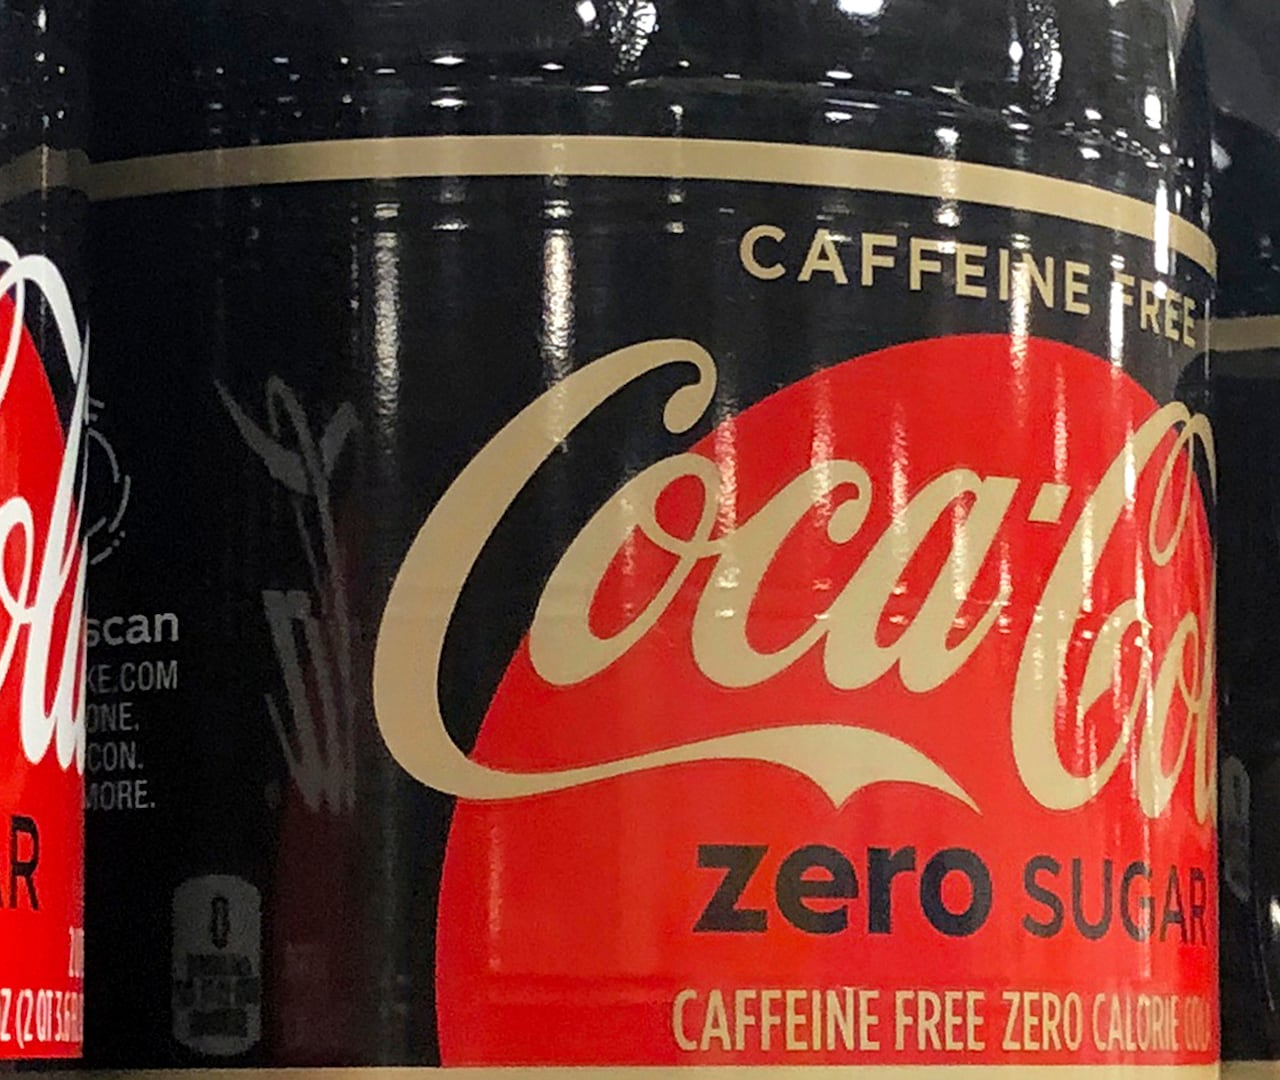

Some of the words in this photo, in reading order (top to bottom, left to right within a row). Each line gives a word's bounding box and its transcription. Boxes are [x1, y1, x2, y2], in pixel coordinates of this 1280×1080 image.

[739, 223, 1091, 316] CAFFEINE
[1113, 271, 1197, 349] FREE
[86, 740, 144, 772] CON.
[692, 844, 993, 938] zero
[1021, 855, 1208, 947] SUGAR
[671, 987, 880, 1052] CAFFEINE
[895, 989, 985, 1052] FREE
[1001, 991, 1083, 1052] ZERO
[1092, 993, 1179, 1052] CALORIE
